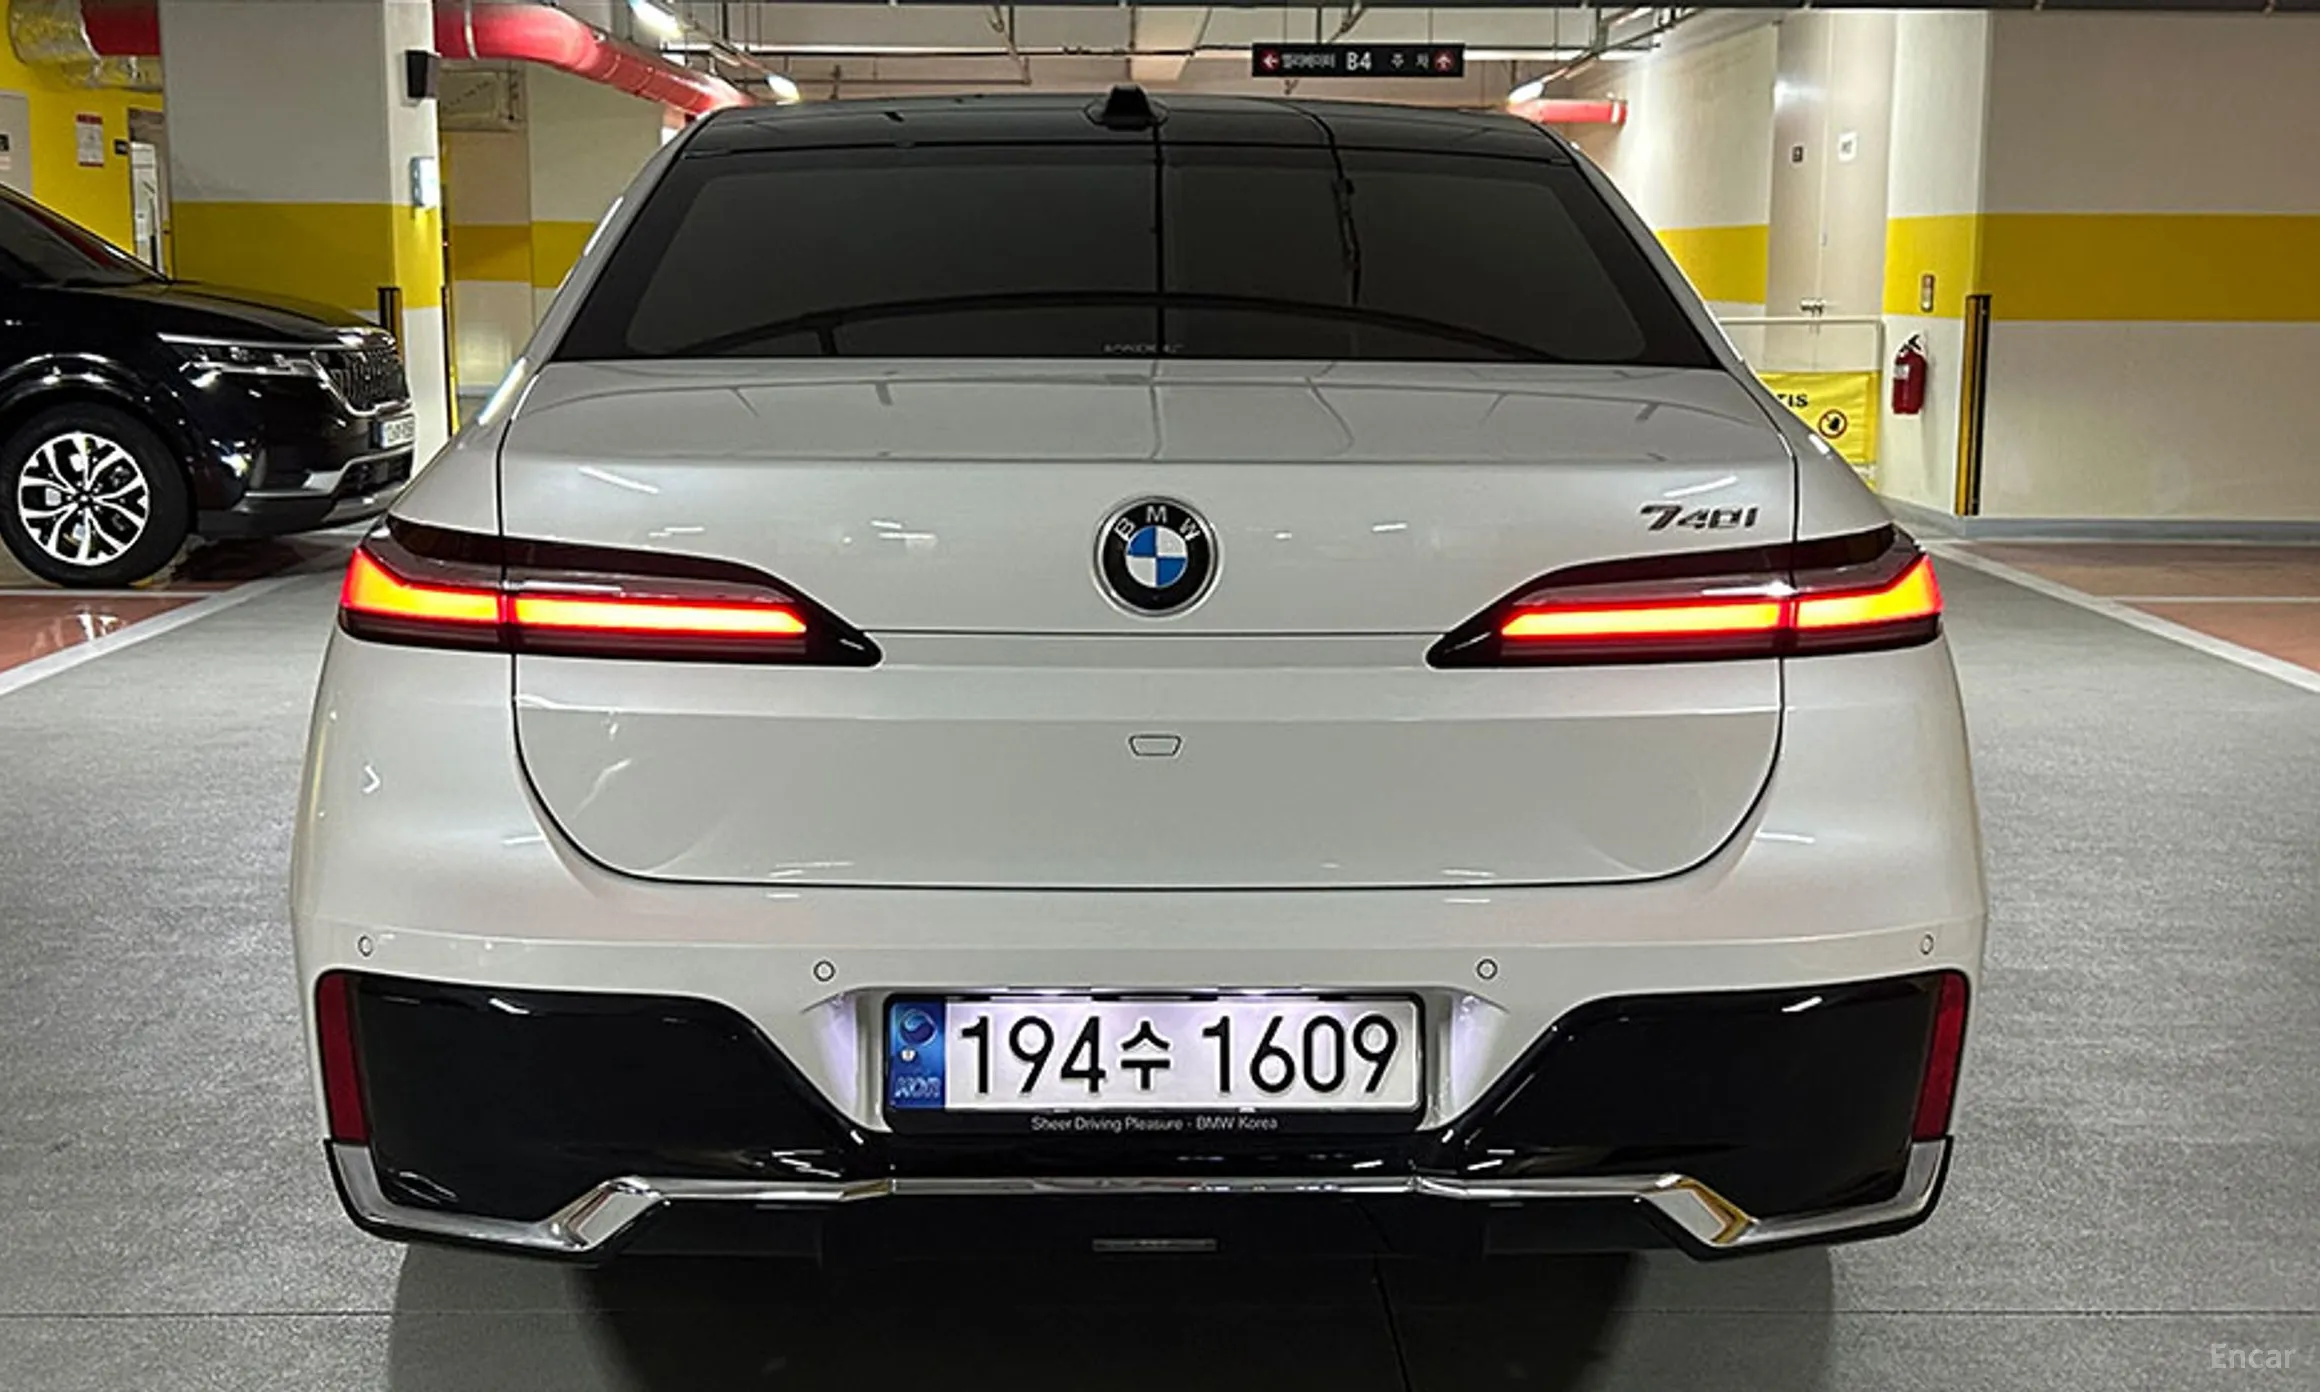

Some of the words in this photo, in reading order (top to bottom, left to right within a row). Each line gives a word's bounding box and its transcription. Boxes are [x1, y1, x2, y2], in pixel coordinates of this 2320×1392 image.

[1346, 51, 1373, 71] B4
[1114, 505, 1200, 541] BMW
[961, 1015, 1171, 1094] 194수
[1203, 1014, 1398, 1094] 1609
[1031, 1116, 1072, 1131] Sheer
[1074, 1116, 1122, 1134] Driving
[1125, 1116, 1183, 1131] Pleasure
[1196, 1115, 1236, 1131] BMW
[1238, 1115, 1278, 1131] Korea
